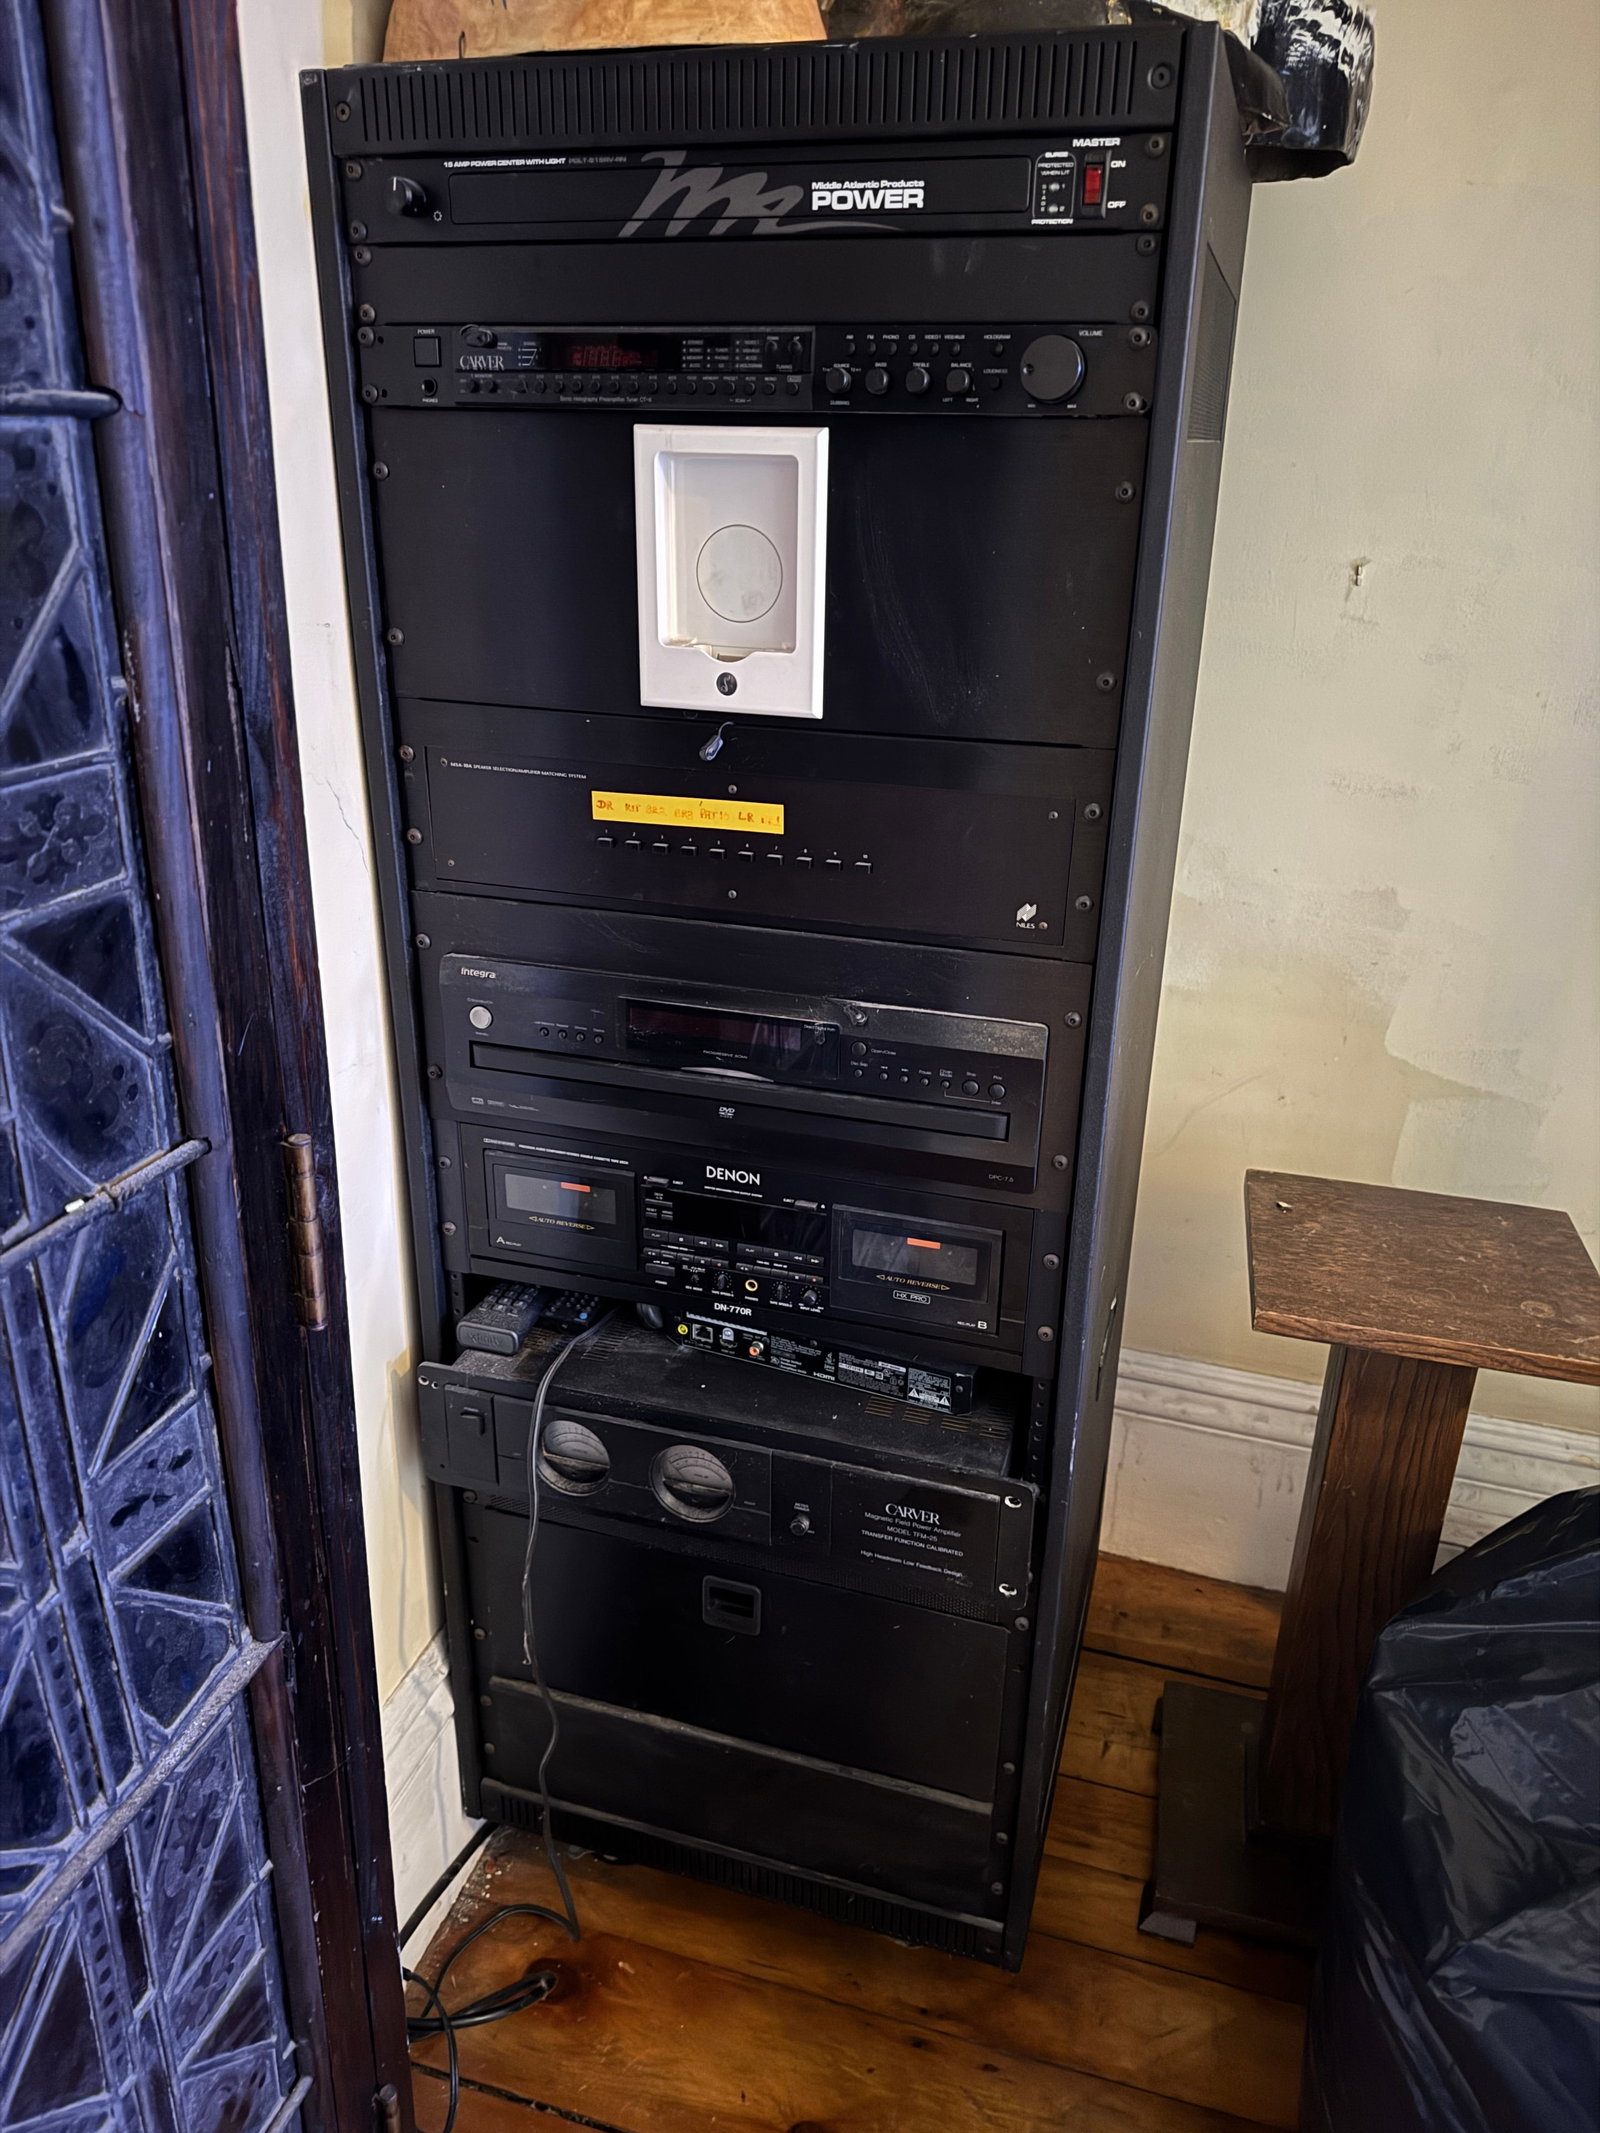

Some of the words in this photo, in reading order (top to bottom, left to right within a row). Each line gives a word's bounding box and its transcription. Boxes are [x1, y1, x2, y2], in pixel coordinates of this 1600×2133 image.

[1072, 137, 1121, 148] MASTER
[453, 160, 470, 168] AMP
[497, 159, 525, 167] CENTER
[525, 158, 545, 166] WITH
[545, 157, 566, 165] LIGHT
[1110, 160, 1126, 168] ON
[811, 182, 842, 190] Middle
[842, 180, 880, 189] Atlantic
[880, 179, 925, 188] Products
[811, 188, 925, 211] POWER
[1107, 200, 1126, 209] OFF
[459, 354, 504, 371] CARVER
[541, 770, 567, 778] MATCHING
[596, 800, 614, 811] DR
[737, 811, 755, 824] LR
[1016, 921, 1036, 930] NILES
[460, 967, 497, 979] Integra
[706, 1165, 761, 1186] DENON
[536, 1217, 556, 1225] AUTO
[556, 1220, 588, 1230] REVERSE
[496, 1236, 505, 1244] A
[885, 1275, 905, 1284] AUTO
[906, 1278, 941, 1290] REVERSE
[909, 1294, 928, 1303] PRO
[714, 1302, 752, 1316] DN-770R
[977, 1321, 988, 1330] B
[813, 1371, 836, 1381] HDMI
[885, 1503, 941, 1526] CARVER
[864, 1511, 894, 1523] Magnetic
[895, 1517, 911, 1527] Field
[912, 1522, 932, 1531] Power
[933, 1527, 962, 1538] Amplifier
[887, 1525, 911, 1536] MODEL
[861, 1529, 893, 1541] TRANSFER
[894, 1536, 925, 1548] FUNCTION
[926, 1544, 964, 1557] CALIBRATED
[860, 1549, 874, 1558] High
[903, 1559, 915, 1567] Low
[943, 1568, 963, 1578] Design
